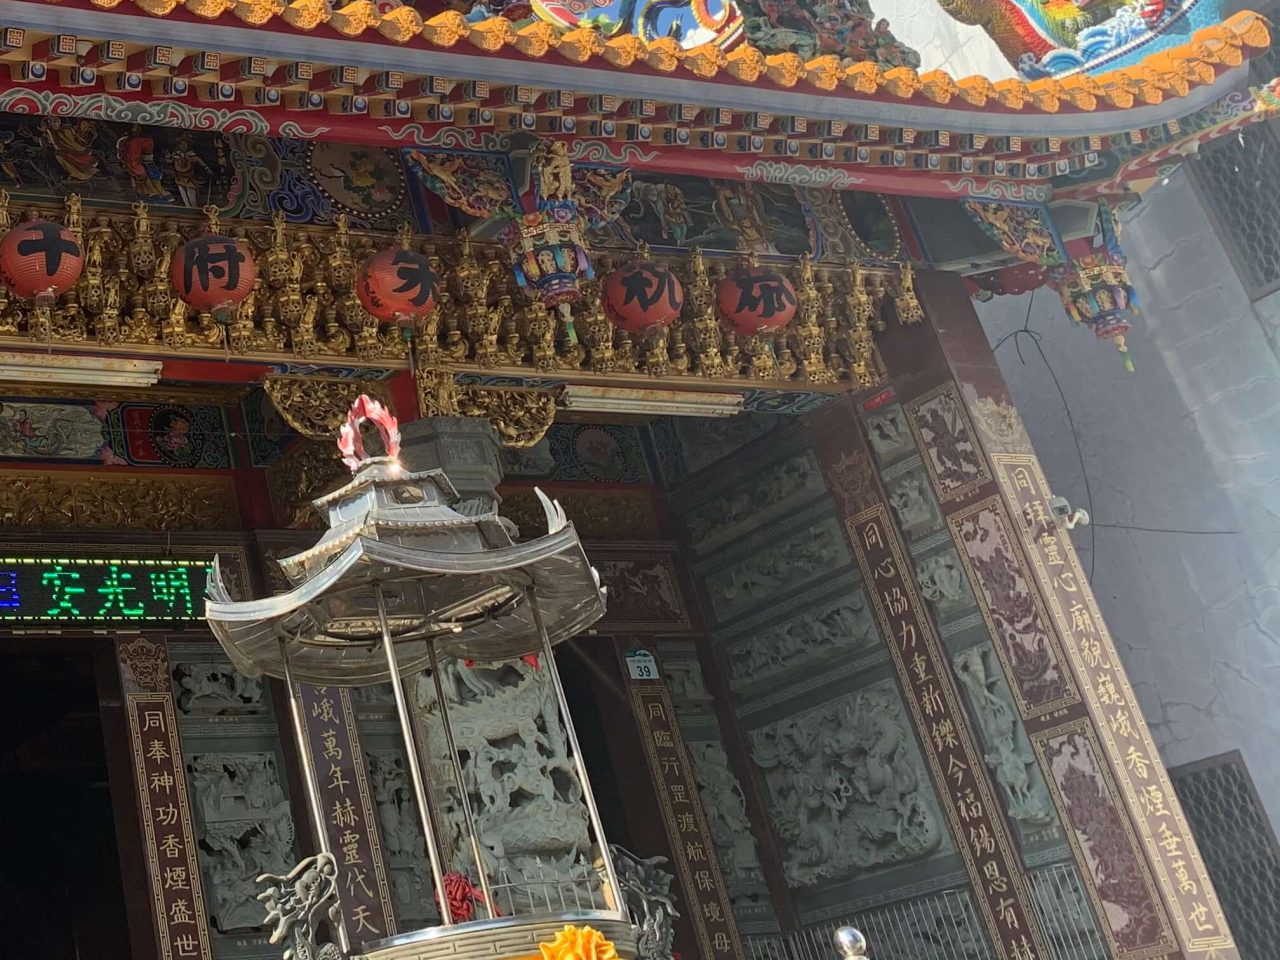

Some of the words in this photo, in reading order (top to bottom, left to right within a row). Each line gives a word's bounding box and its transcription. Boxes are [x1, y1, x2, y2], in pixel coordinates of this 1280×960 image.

[183, 236, 245, 295] 府
[636, 665, 651, 678] 39
[142, 710, 200, 958] 同奉神功香煙盛世
[312, 686, 380, 934] 峨萬年赫靈代天
